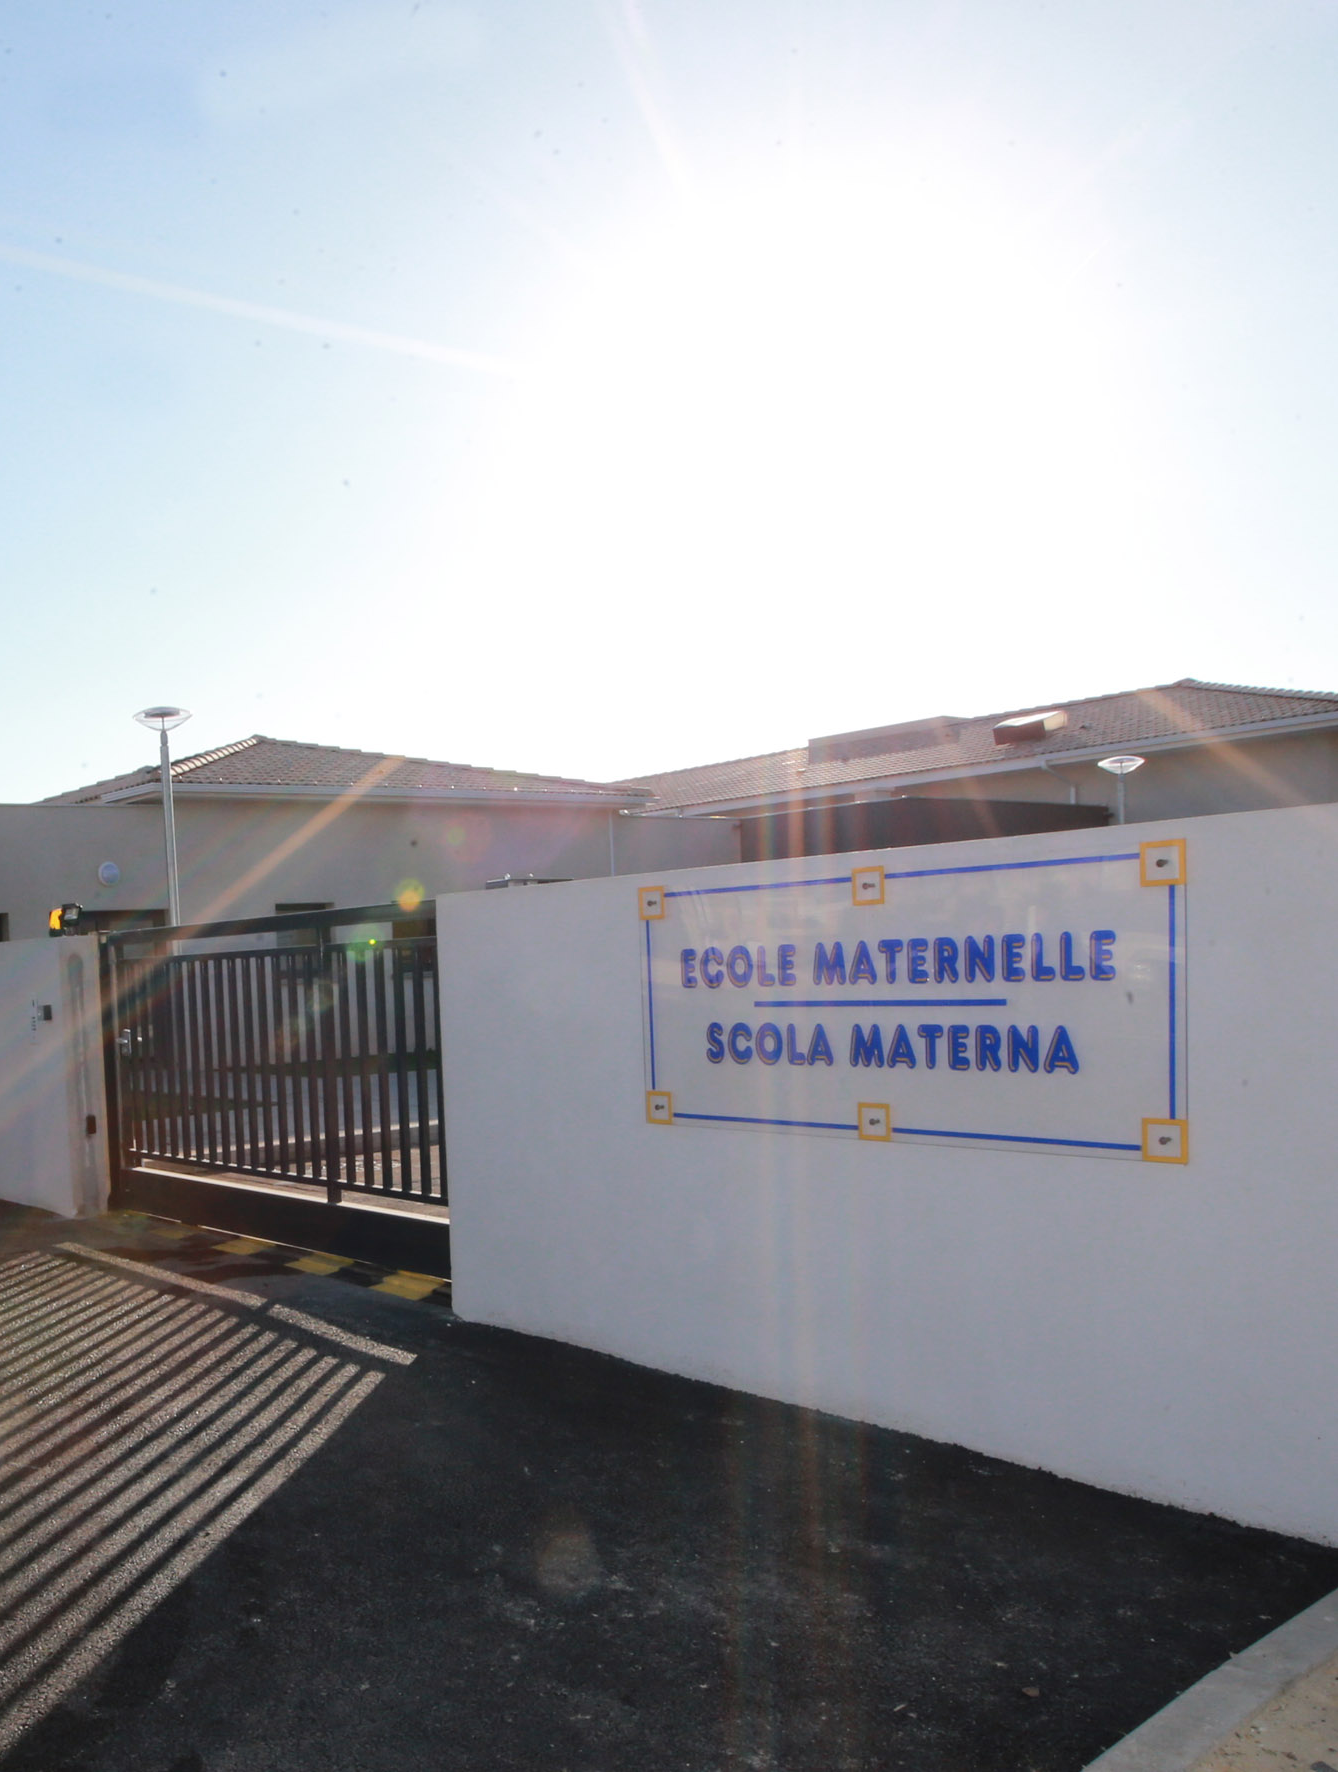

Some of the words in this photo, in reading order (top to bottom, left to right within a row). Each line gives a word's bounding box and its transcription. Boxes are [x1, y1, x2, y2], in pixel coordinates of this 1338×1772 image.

[680, 943, 797, 989] ECOLE
[813, 930, 1117, 986] MATERNELLE
[706, 1022, 834, 1066] SCOLA
[850, 1023, 1080, 1075] MATERNA
